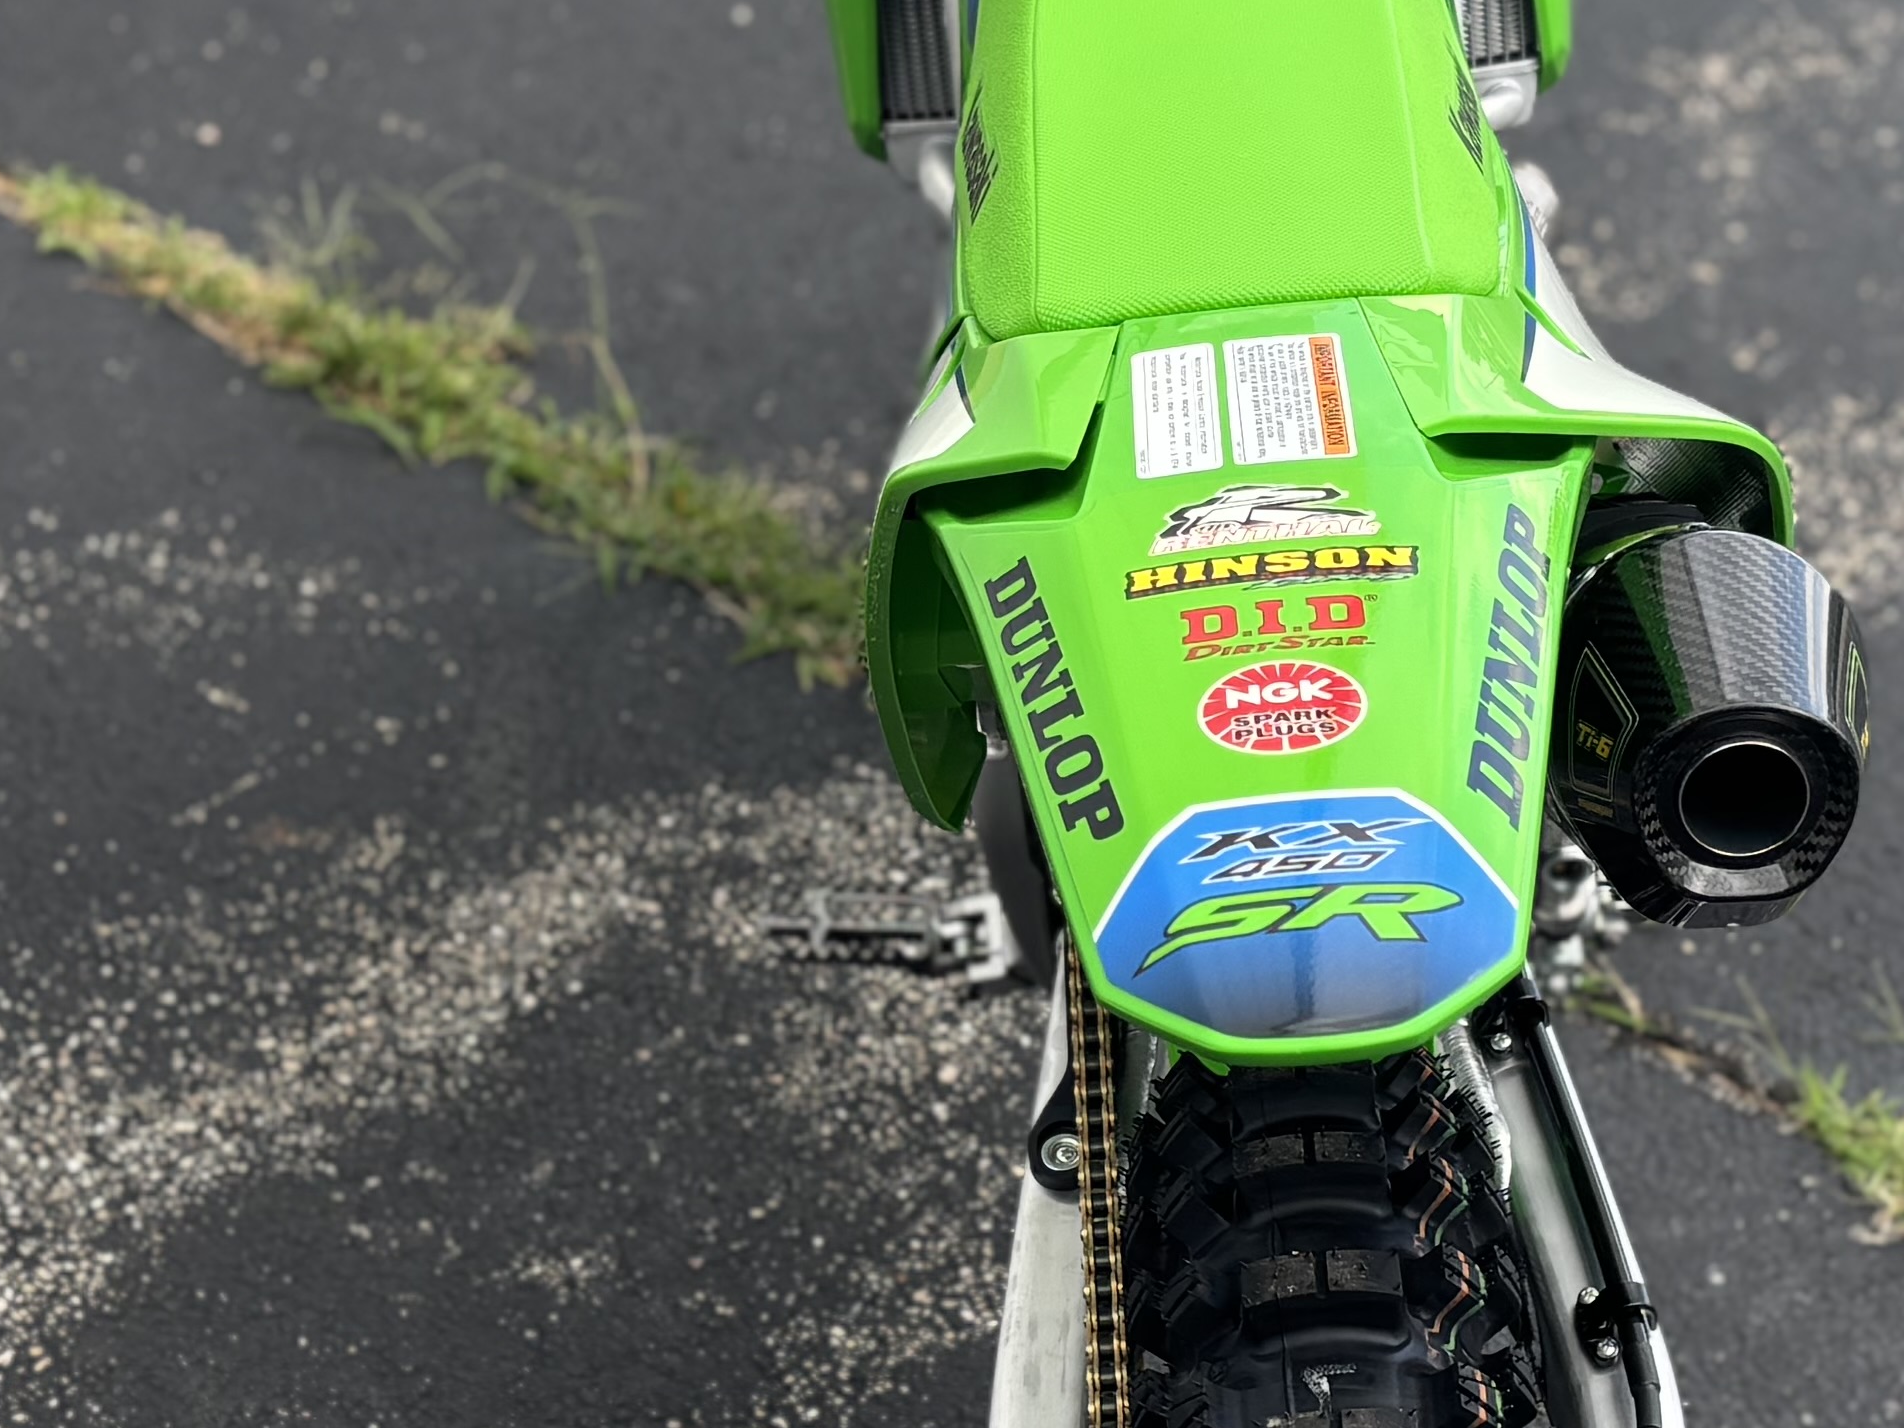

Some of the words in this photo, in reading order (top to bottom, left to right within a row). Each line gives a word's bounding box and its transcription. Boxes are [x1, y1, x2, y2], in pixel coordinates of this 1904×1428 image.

[1129, 545, 1416, 594] HINSON
[1180, 594, 1367, 645] D.I.D
[1466, 502, 1551, 833] DUNLOP
[983, 555, 1125, 841] DUNLOP
[1225, 677, 1334, 709] NGK
[1233, 708, 1333, 727] SPARK
[1234, 721, 1336, 740] PLUGS
[1179, 818, 1432, 864] KX
[1202, 848, 1396, 884] 450
[1132, 881, 1465, 980] SR
